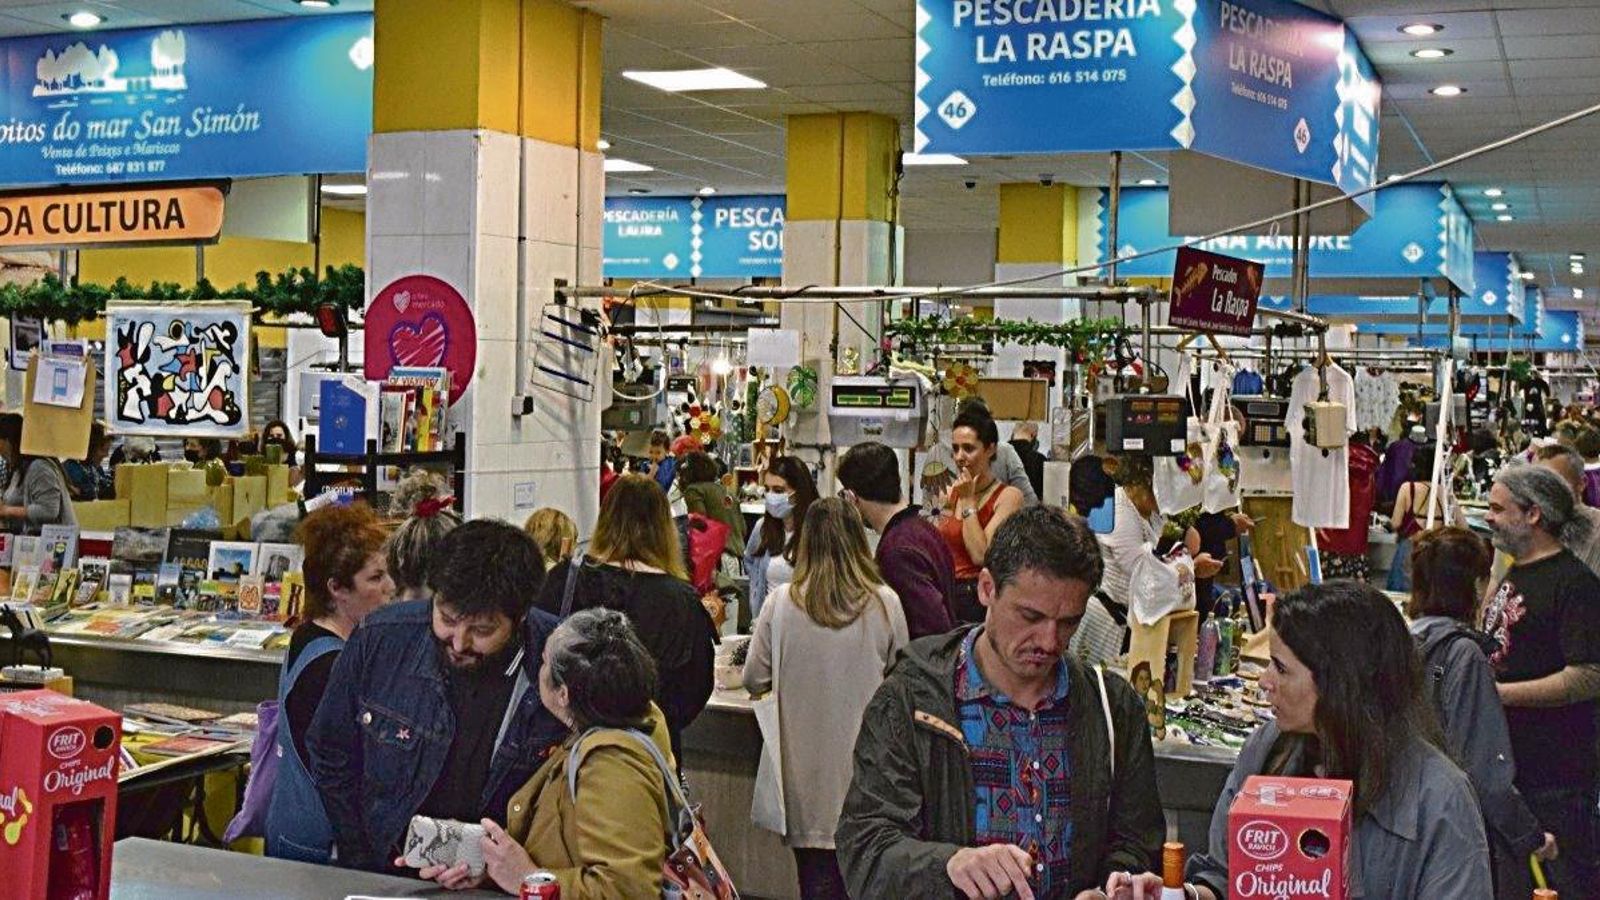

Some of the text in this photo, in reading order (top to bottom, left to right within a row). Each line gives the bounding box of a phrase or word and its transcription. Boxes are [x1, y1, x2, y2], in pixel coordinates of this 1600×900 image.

[975, 28, 1137, 64] LA RASPA
[983, 69, 1126, 87] Teléfono: 616 514 075
[1229, 43, 1293, 89] LA RASPA
[53, 111, 80, 140] do
[87, 118, 133, 139] mar
[134, 108, 182, 140] San
[185, 103, 261, 138] Simón
[943, 102, 967, 118] 46
[1296, 127, 1307, 144] 46
[55, 162, 103, 175] Teléfono:
[42, 197, 186, 235] CULTURA
[1211, 287, 1250, 321] La Raspa
[54, 732, 80, 747] FRIT
[44, 755, 114, 795] Original
[1245, 829, 1280, 844] FRIT
[1255, 863, 1284, 872] CHIPS
[1236, 868, 1331, 900] Original
